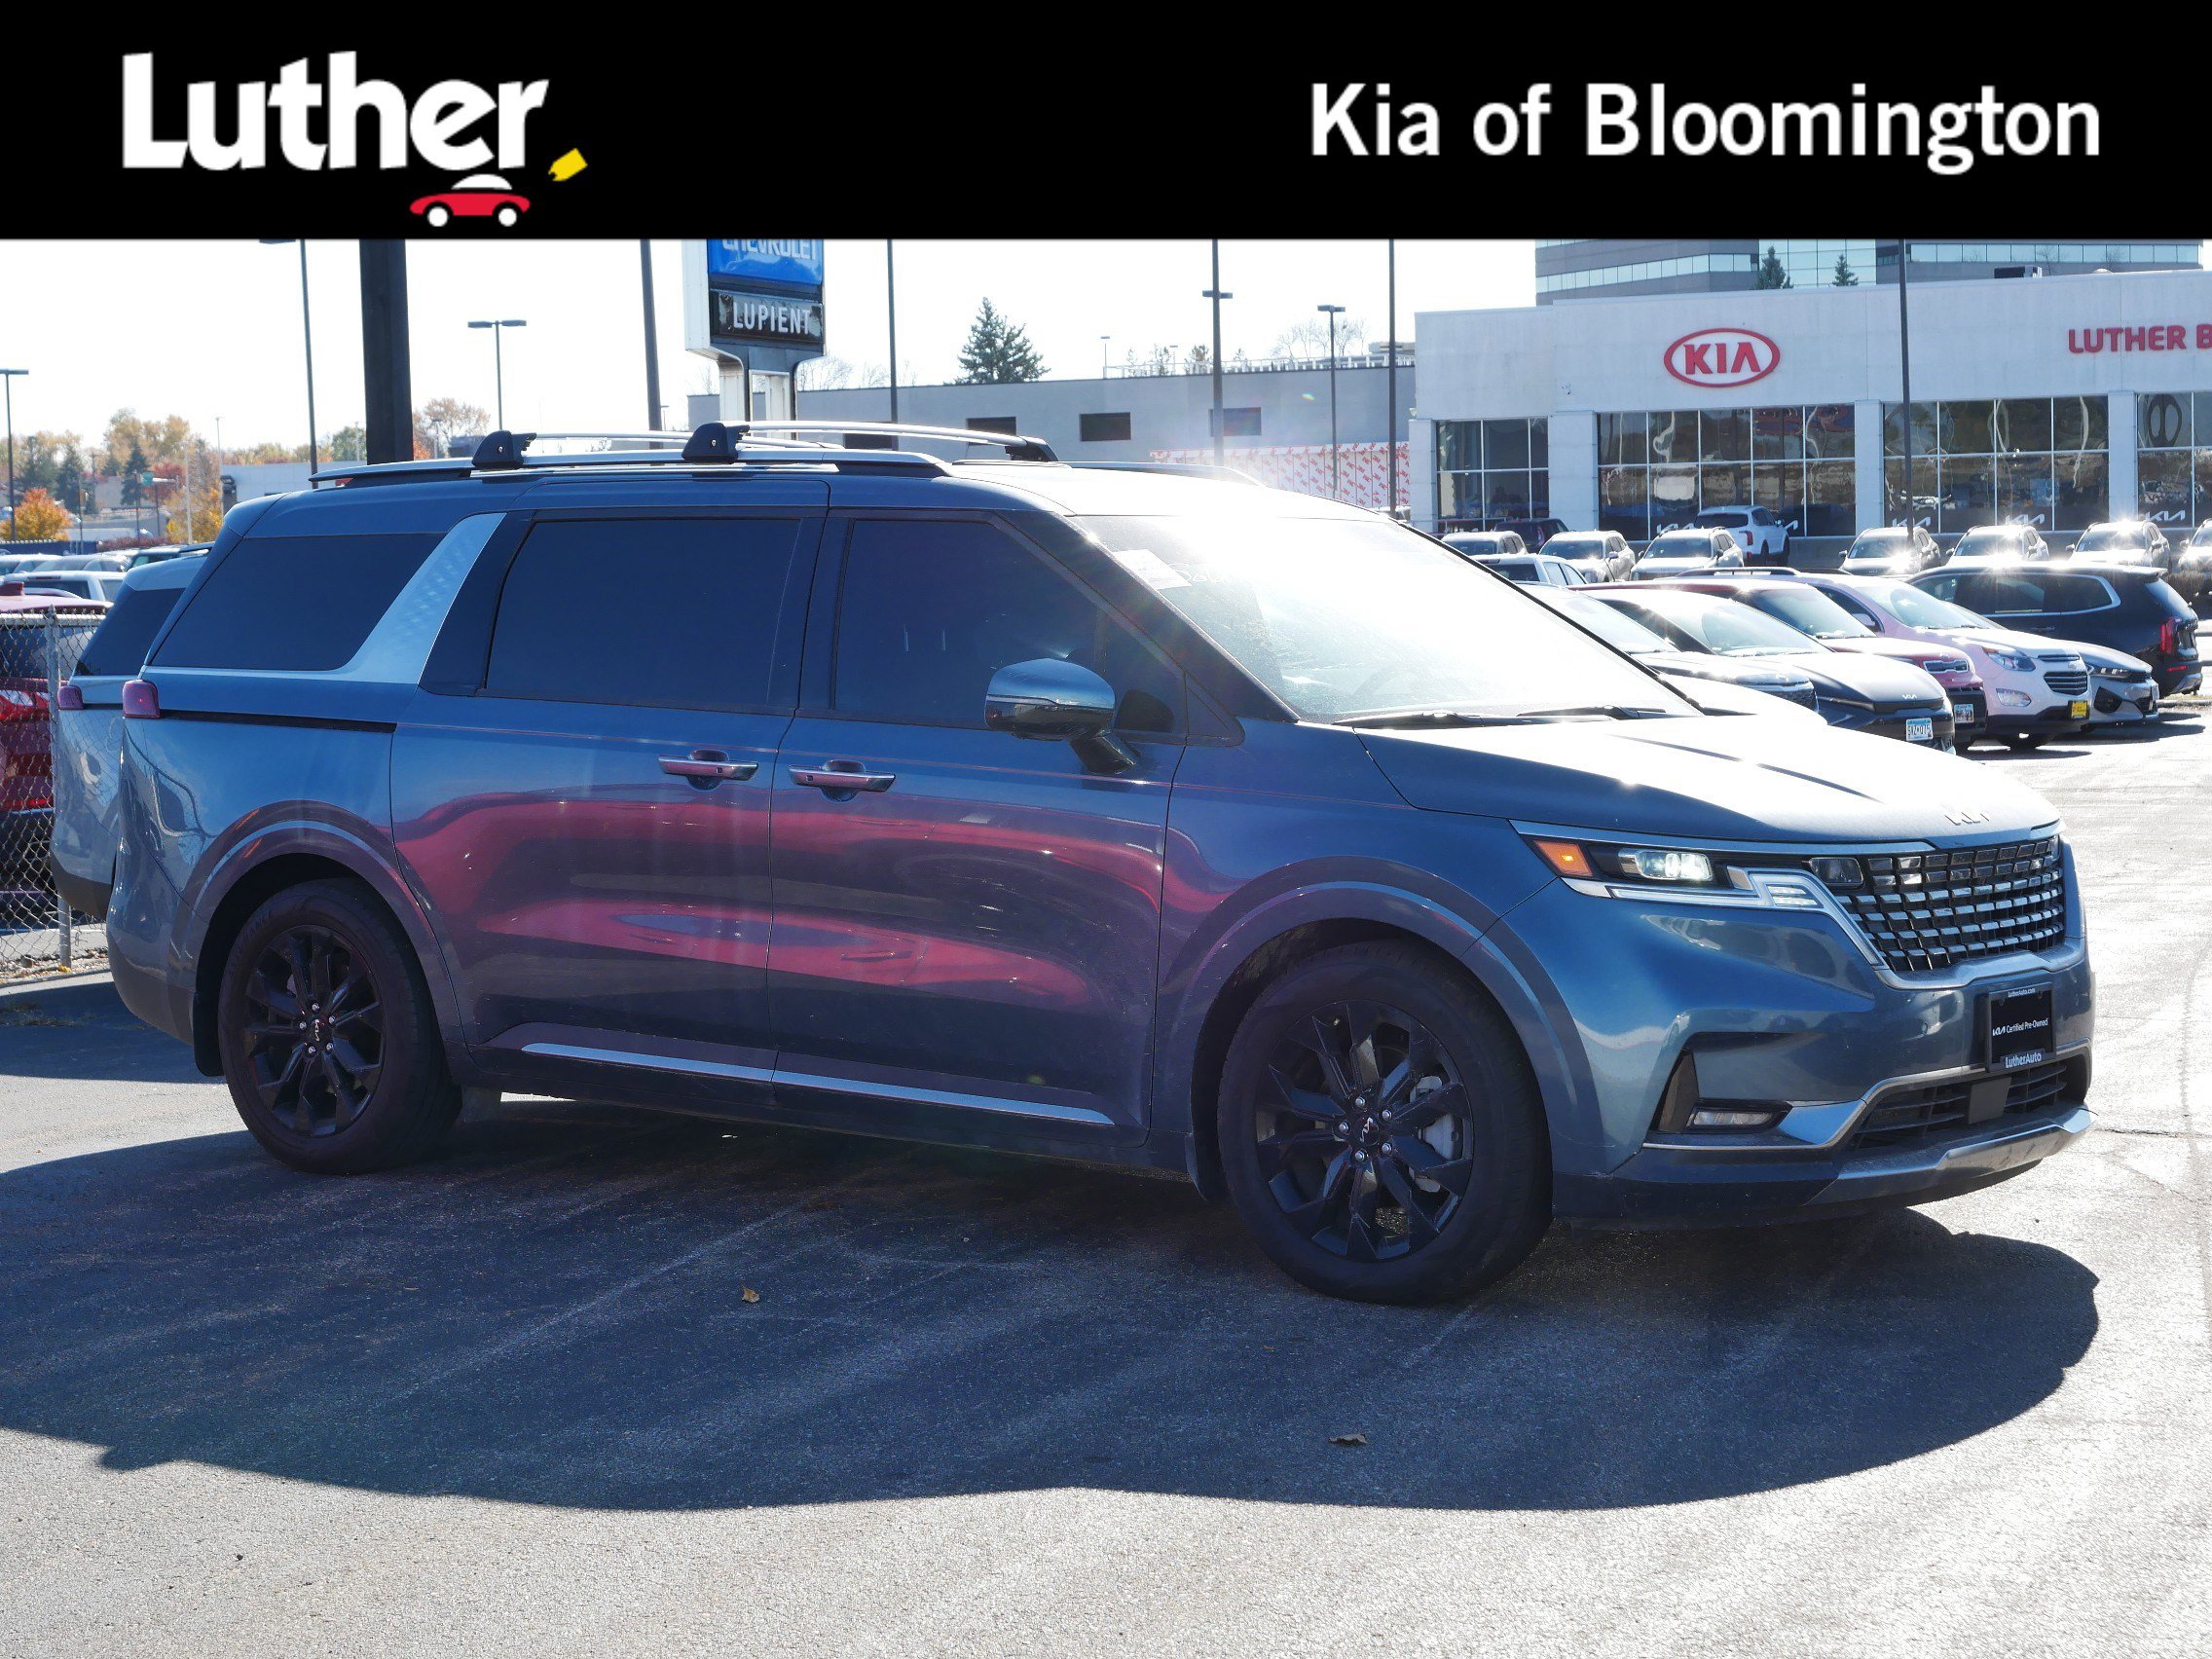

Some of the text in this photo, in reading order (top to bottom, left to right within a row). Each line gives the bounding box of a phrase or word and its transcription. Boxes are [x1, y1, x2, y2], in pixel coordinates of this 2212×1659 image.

[733, 301, 811, 334] LUPIENT
[2069, 325, 2186, 353] LUTHER
[1683, 342, 1761, 375] KIA
[1892, 516, 1932, 528] KA
[2007, 1022, 2024, 1033] Certified
[2006, 1051, 2042, 1068] LutherAuto
